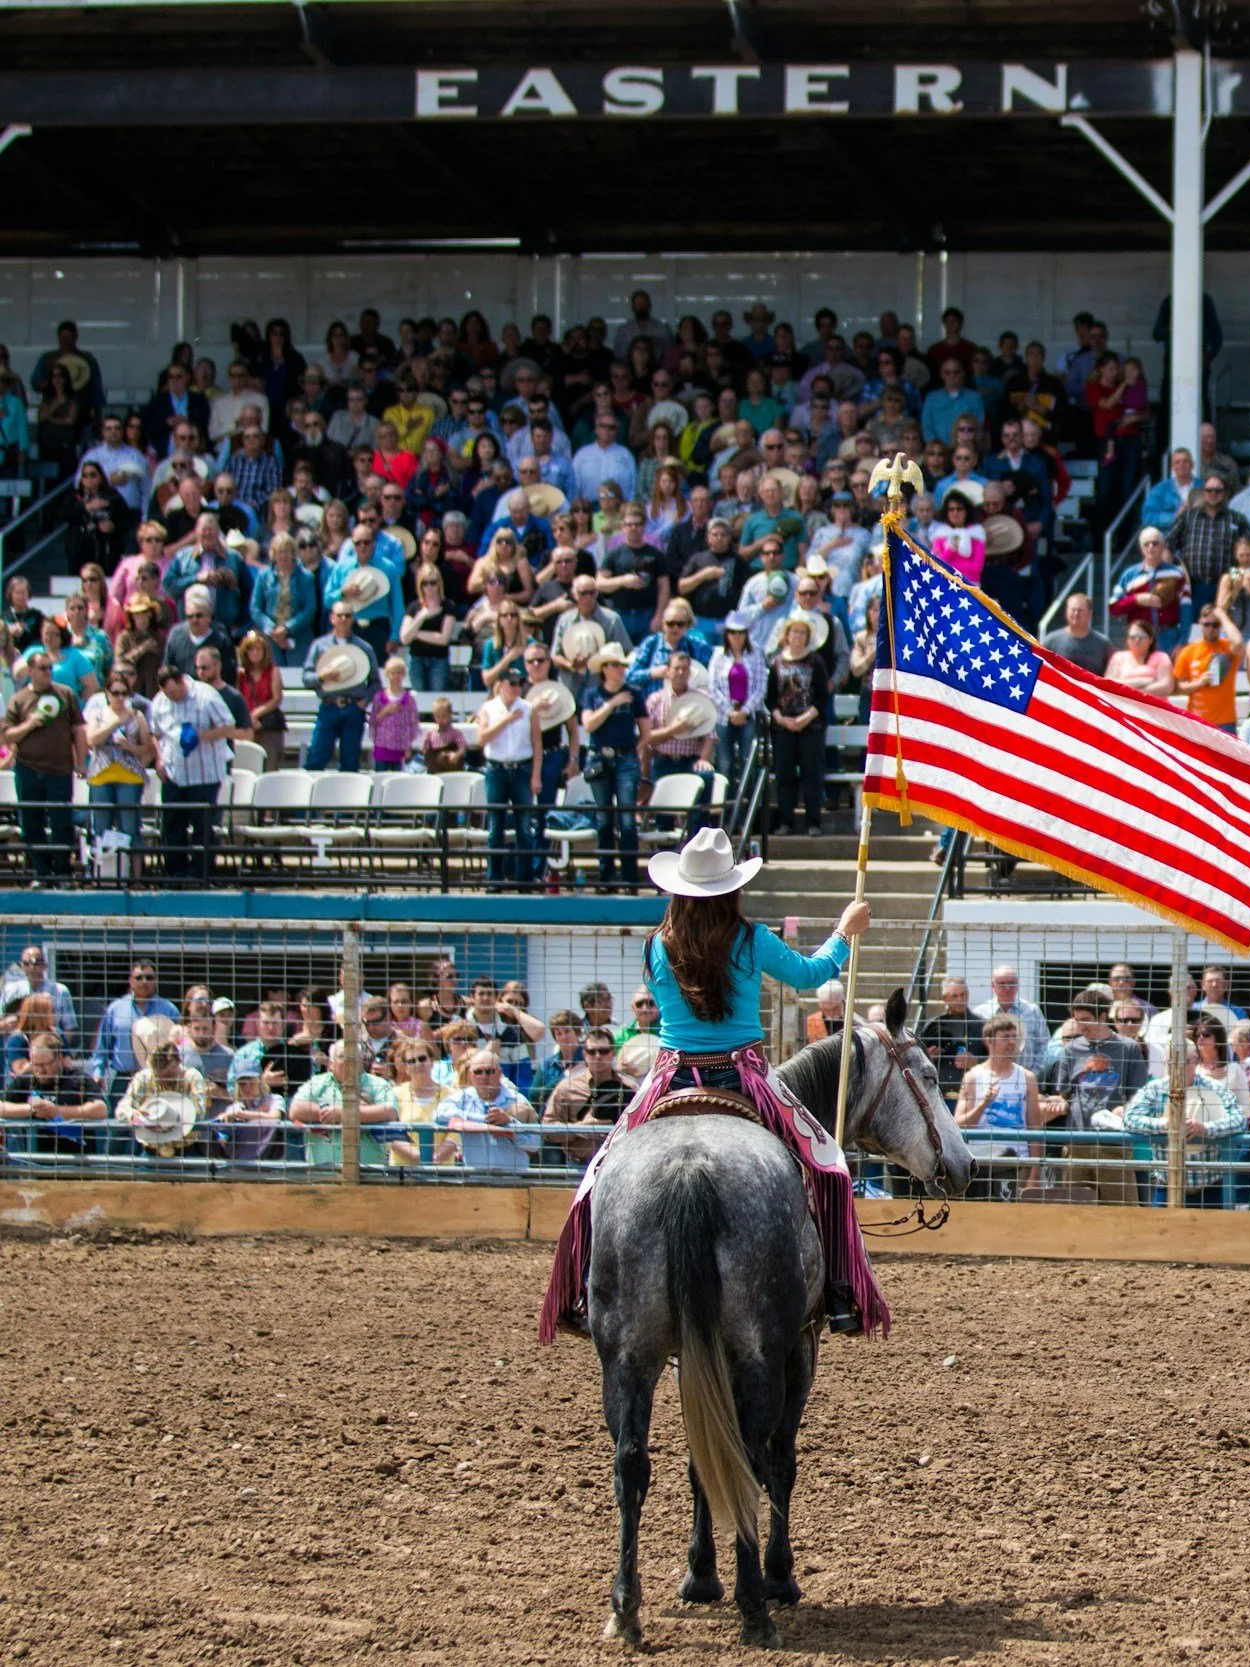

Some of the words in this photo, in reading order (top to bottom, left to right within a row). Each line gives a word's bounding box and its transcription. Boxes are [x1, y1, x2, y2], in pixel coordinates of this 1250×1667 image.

[417, 63, 1067, 115] EASTERN
[310, 837, 334, 867] I
[546, 839, 570, 869] J
